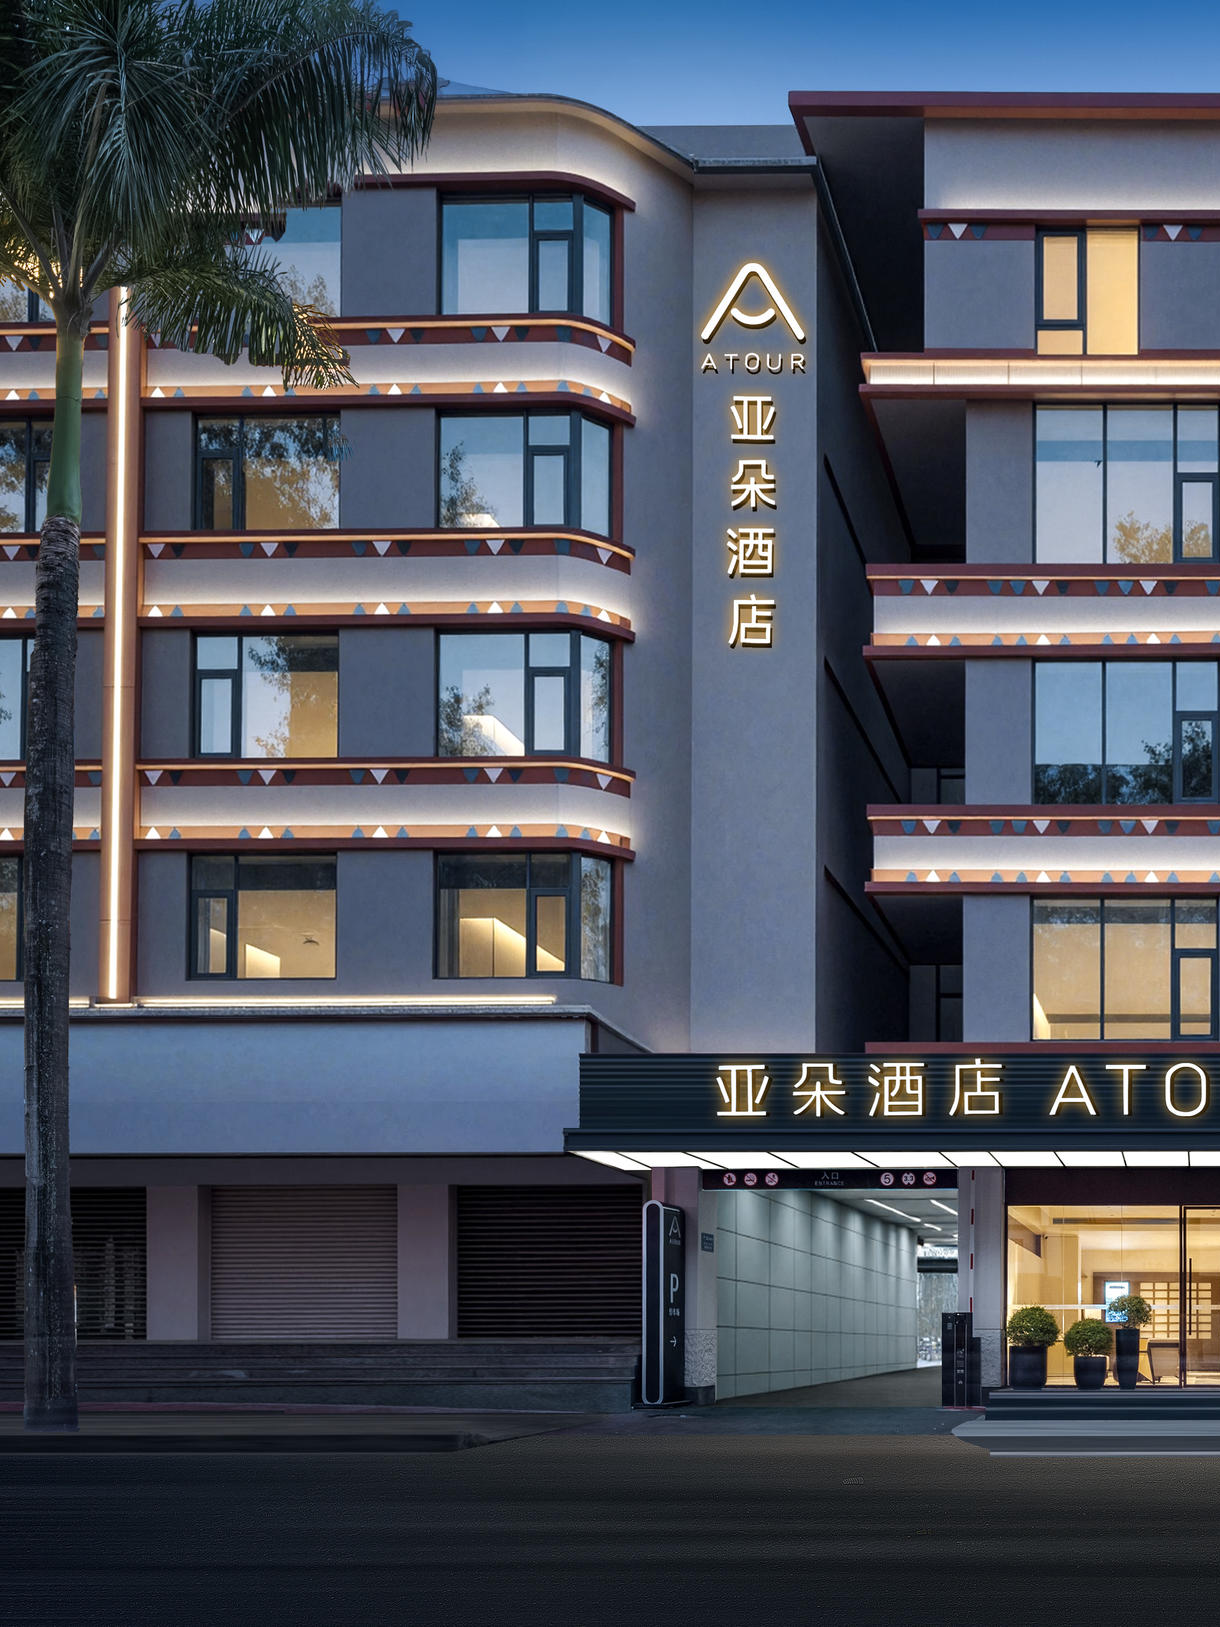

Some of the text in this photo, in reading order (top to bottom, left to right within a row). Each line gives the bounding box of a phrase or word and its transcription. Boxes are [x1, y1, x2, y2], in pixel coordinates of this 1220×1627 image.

[701, 352, 806, 372] ATOUR
[726, 395, 776, 646] 亚朵酒店
[715, 1057, 1004, 1117] 亚朵酒店
[821, 1171, 839, 1180] 入口
[883, 1174, 891, 1184] 5
[670, 1273, 679, 1304] P
